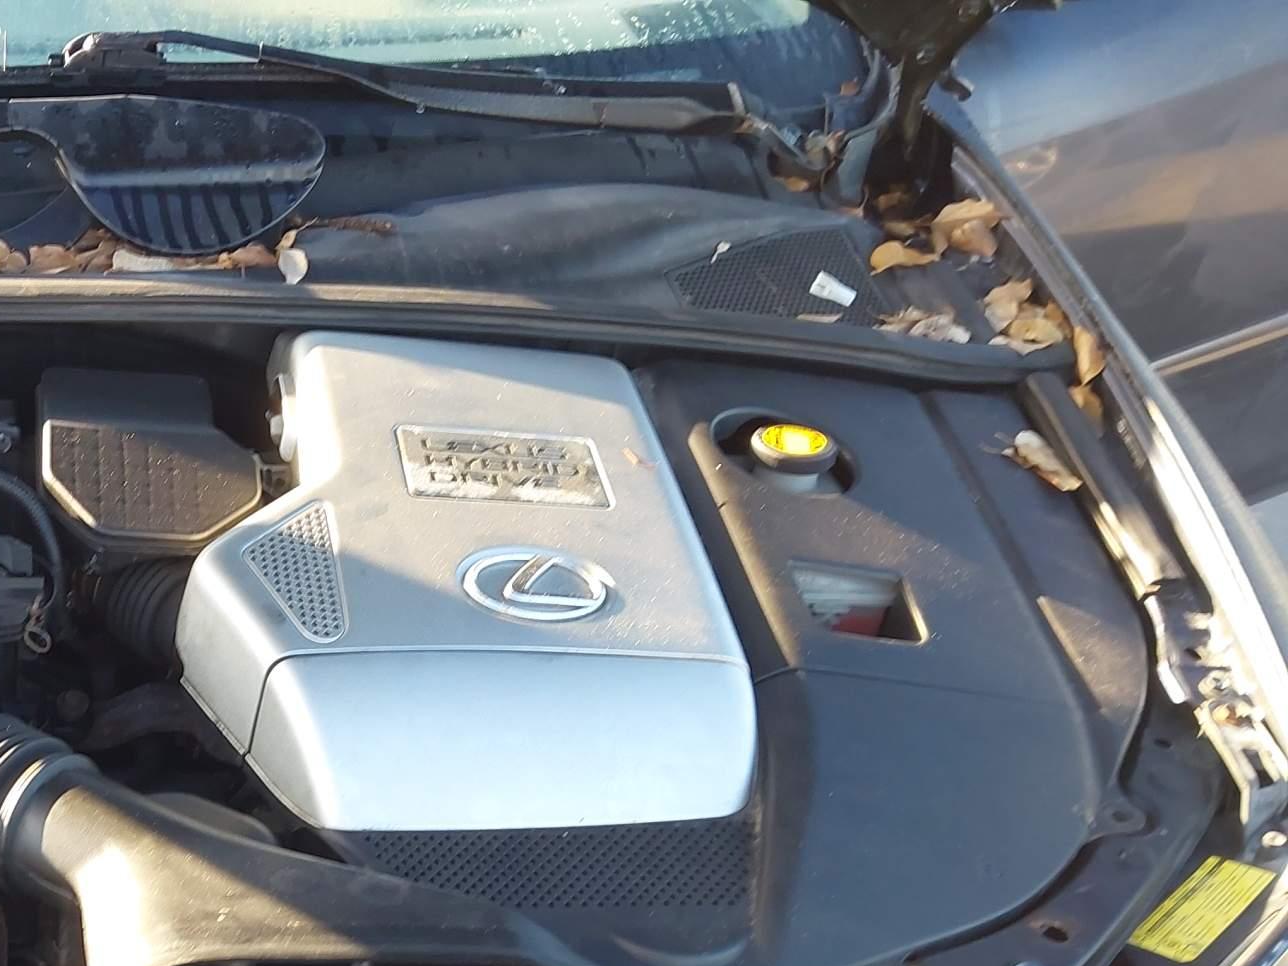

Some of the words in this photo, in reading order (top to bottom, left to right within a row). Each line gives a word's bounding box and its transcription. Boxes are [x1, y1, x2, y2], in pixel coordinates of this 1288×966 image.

[420, 437, 571, 460] LEXUS
[424, 452, 584, 477] HYBRID
[429, 470, 563, 488] DRIVE
